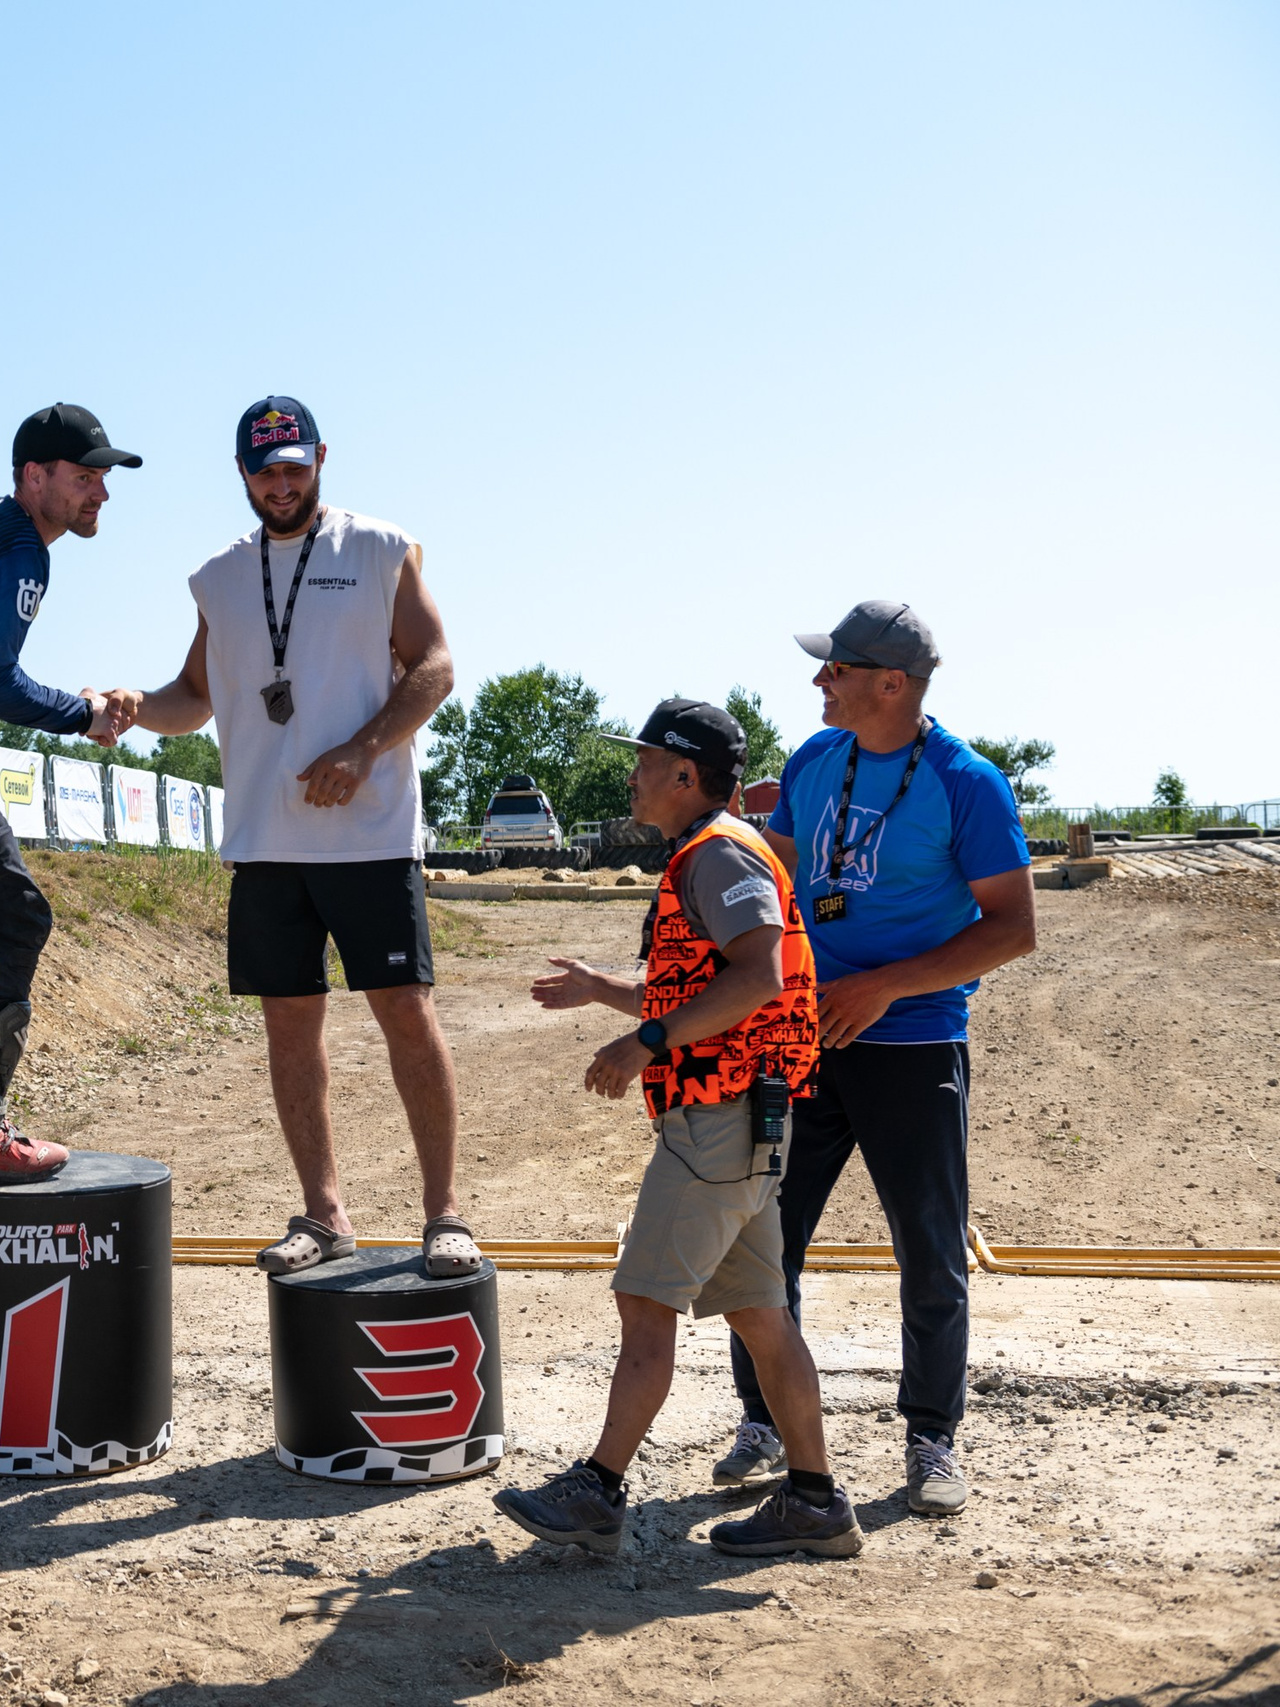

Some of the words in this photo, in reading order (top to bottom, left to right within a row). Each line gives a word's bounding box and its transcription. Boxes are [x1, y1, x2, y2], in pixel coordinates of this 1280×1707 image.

[252, 430, 275, 448] Red
[276, 427, 300, 442] Bull
[308, 577, 357, 587] ESSENTIALS
[4, 777, 29, 797] Сетевой
[819, 895, 845, 914] STAFF
[56, 1224, 75, 1234] PARK
[350, 1310, 486, 1448] 3
